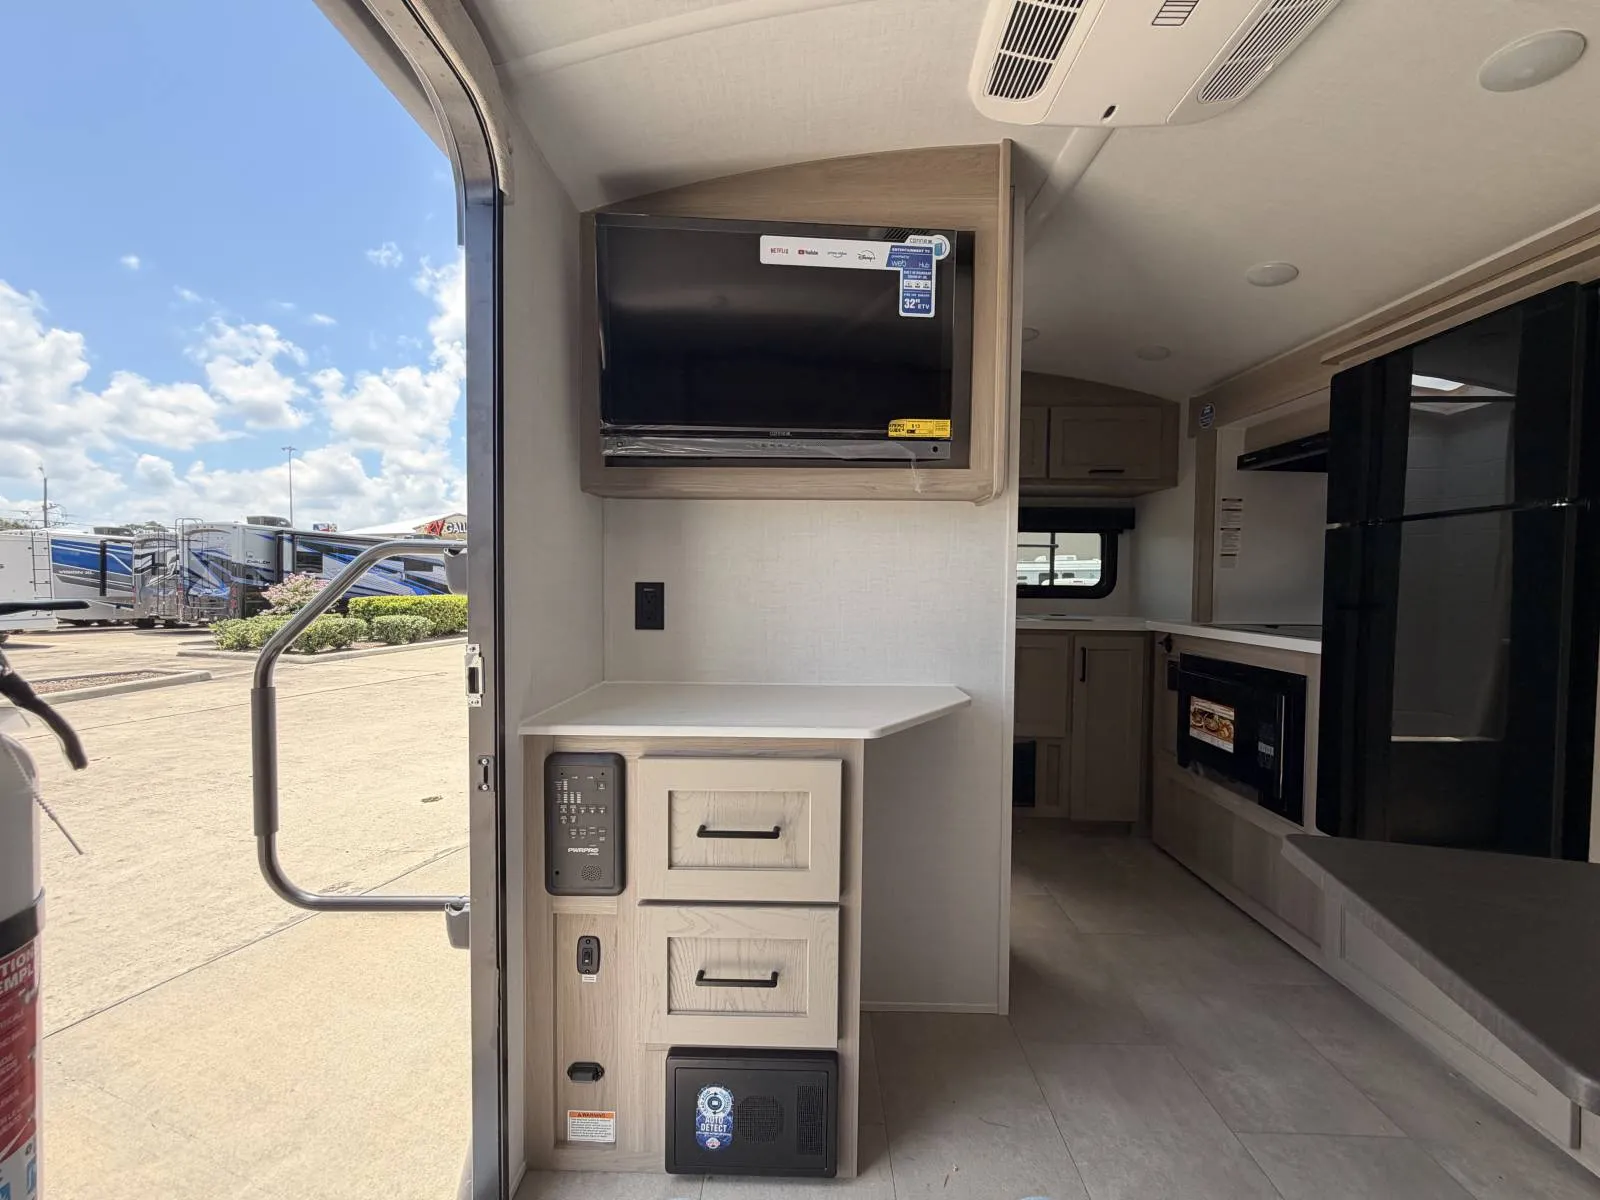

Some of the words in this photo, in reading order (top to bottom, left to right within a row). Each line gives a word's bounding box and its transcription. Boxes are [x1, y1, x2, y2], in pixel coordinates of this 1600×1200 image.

[770, 247, 789, 255] NETFLIX
[704, 1115, 724, 1125] AUTO
[700, 1123, 728, 1133] DETECT
